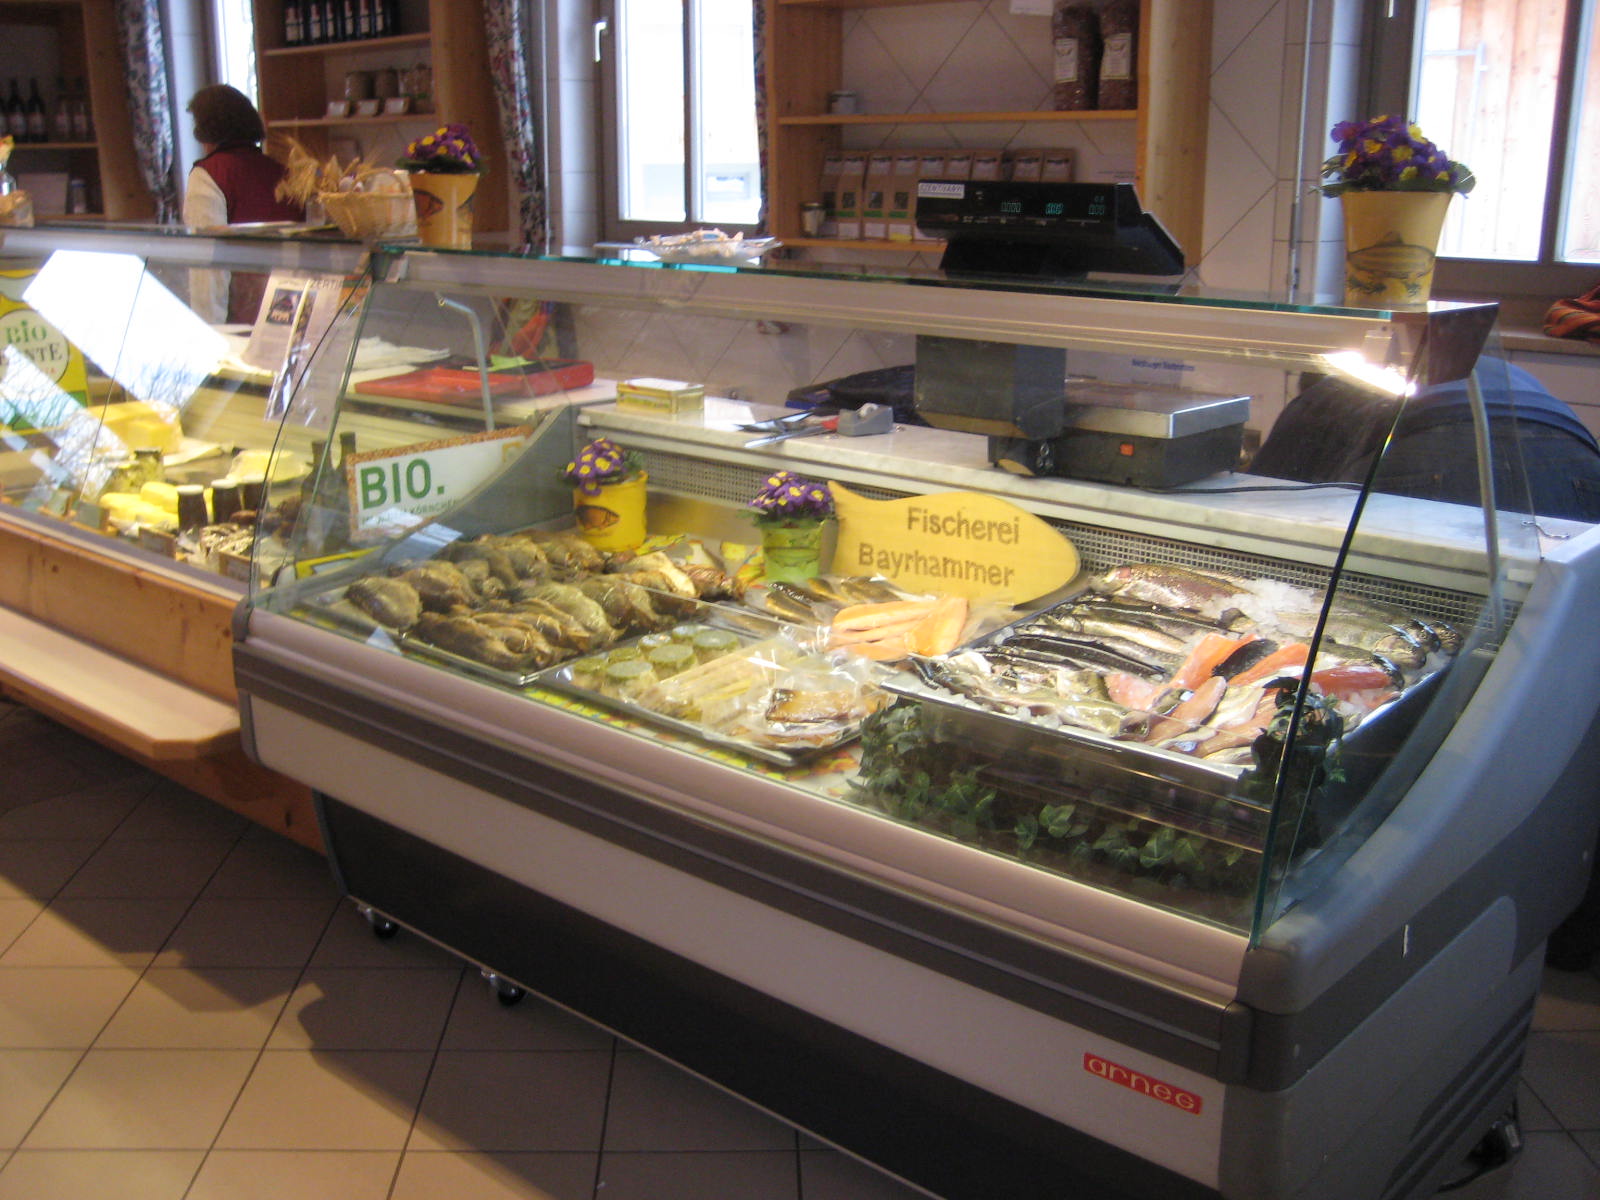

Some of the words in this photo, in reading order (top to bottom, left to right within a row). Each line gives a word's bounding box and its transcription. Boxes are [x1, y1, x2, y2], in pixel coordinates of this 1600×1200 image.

[360, 458, 445, 510] BIO.
[907, 506, 1020, 544] Fischerei
[858, 542, 1015, 587] Bayrhammer
